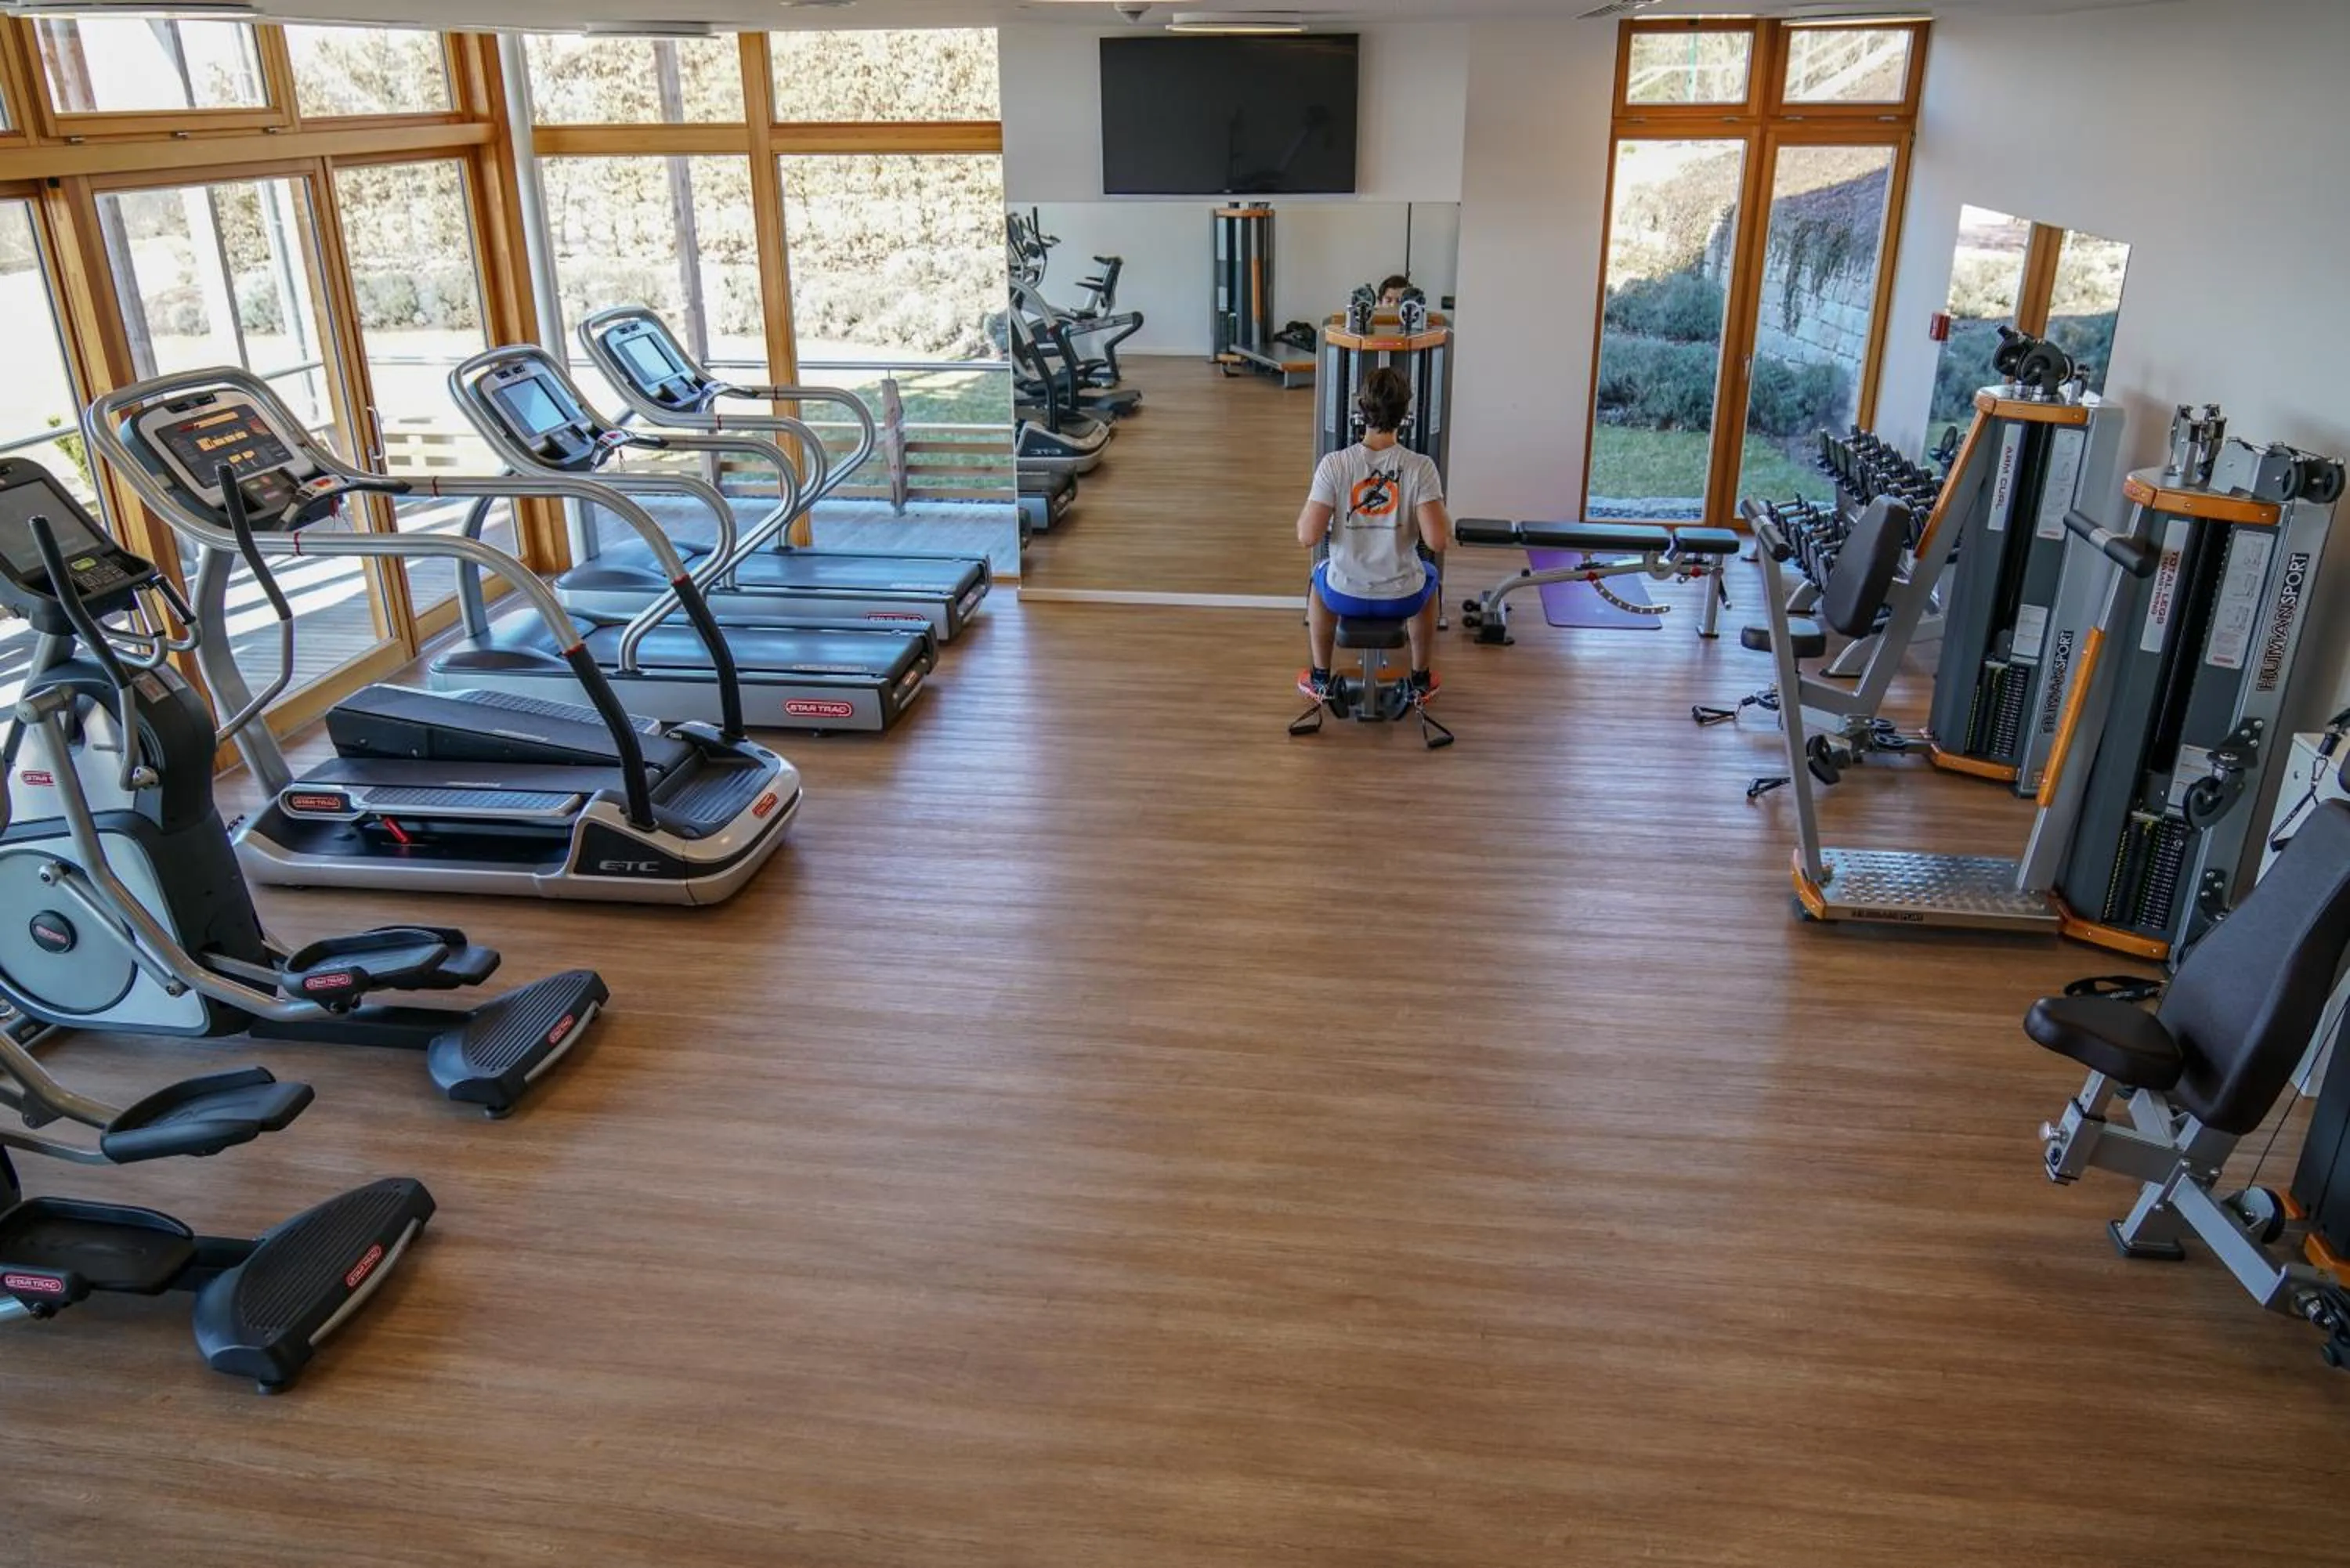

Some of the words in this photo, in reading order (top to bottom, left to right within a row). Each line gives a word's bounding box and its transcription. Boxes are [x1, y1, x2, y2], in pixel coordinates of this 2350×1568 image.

[2003, 446, 2014, 474] ARM
[1995, 478, 2008, 510] CURL
[2164, 551, 2180, 588] TOTAL
[2156, 592, 2169, 624] LEGS
[2256, 552, 2310, 691] HUMANSPORT
[598, 860, 660, 872] ETC
